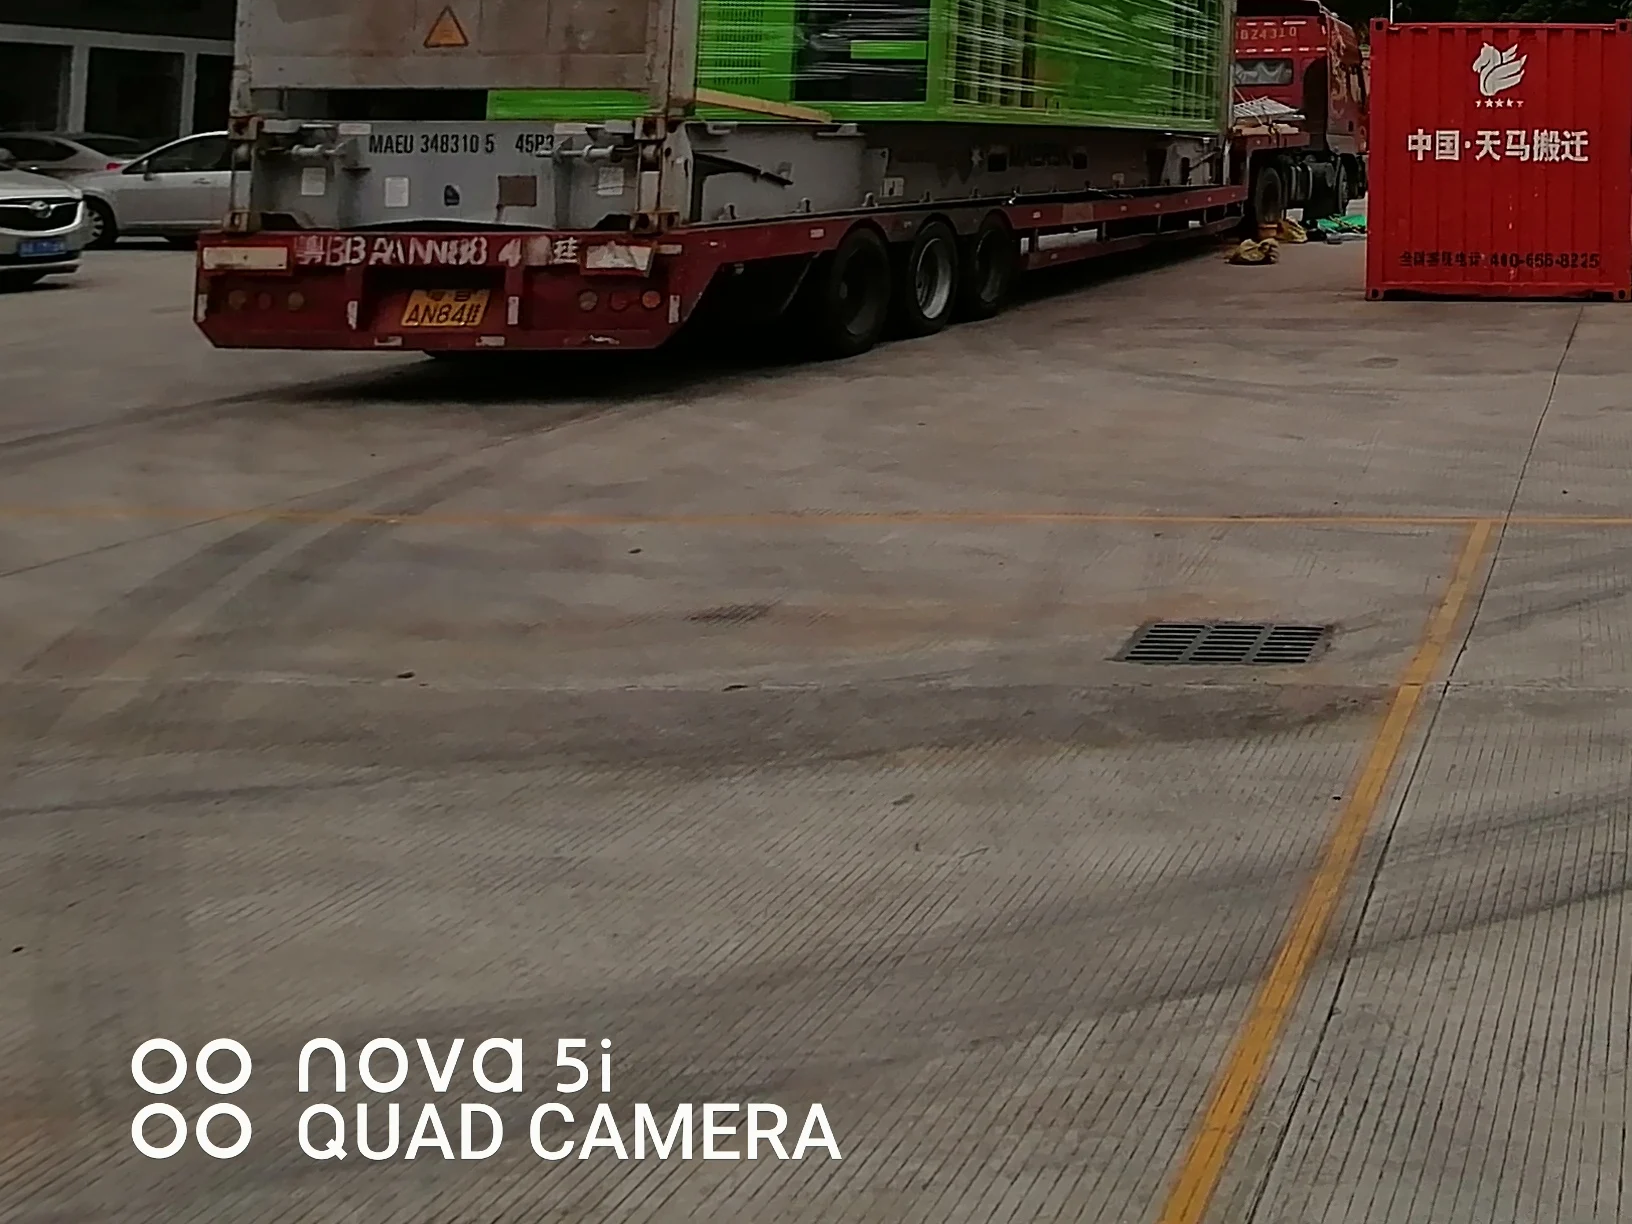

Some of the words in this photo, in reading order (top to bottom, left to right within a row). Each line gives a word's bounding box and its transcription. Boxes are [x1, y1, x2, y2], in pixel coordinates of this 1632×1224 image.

[368, 134, 414, 153] MAEU
[420, 133, 480, 154] 348310
[485, 134, 495, 154] 5
